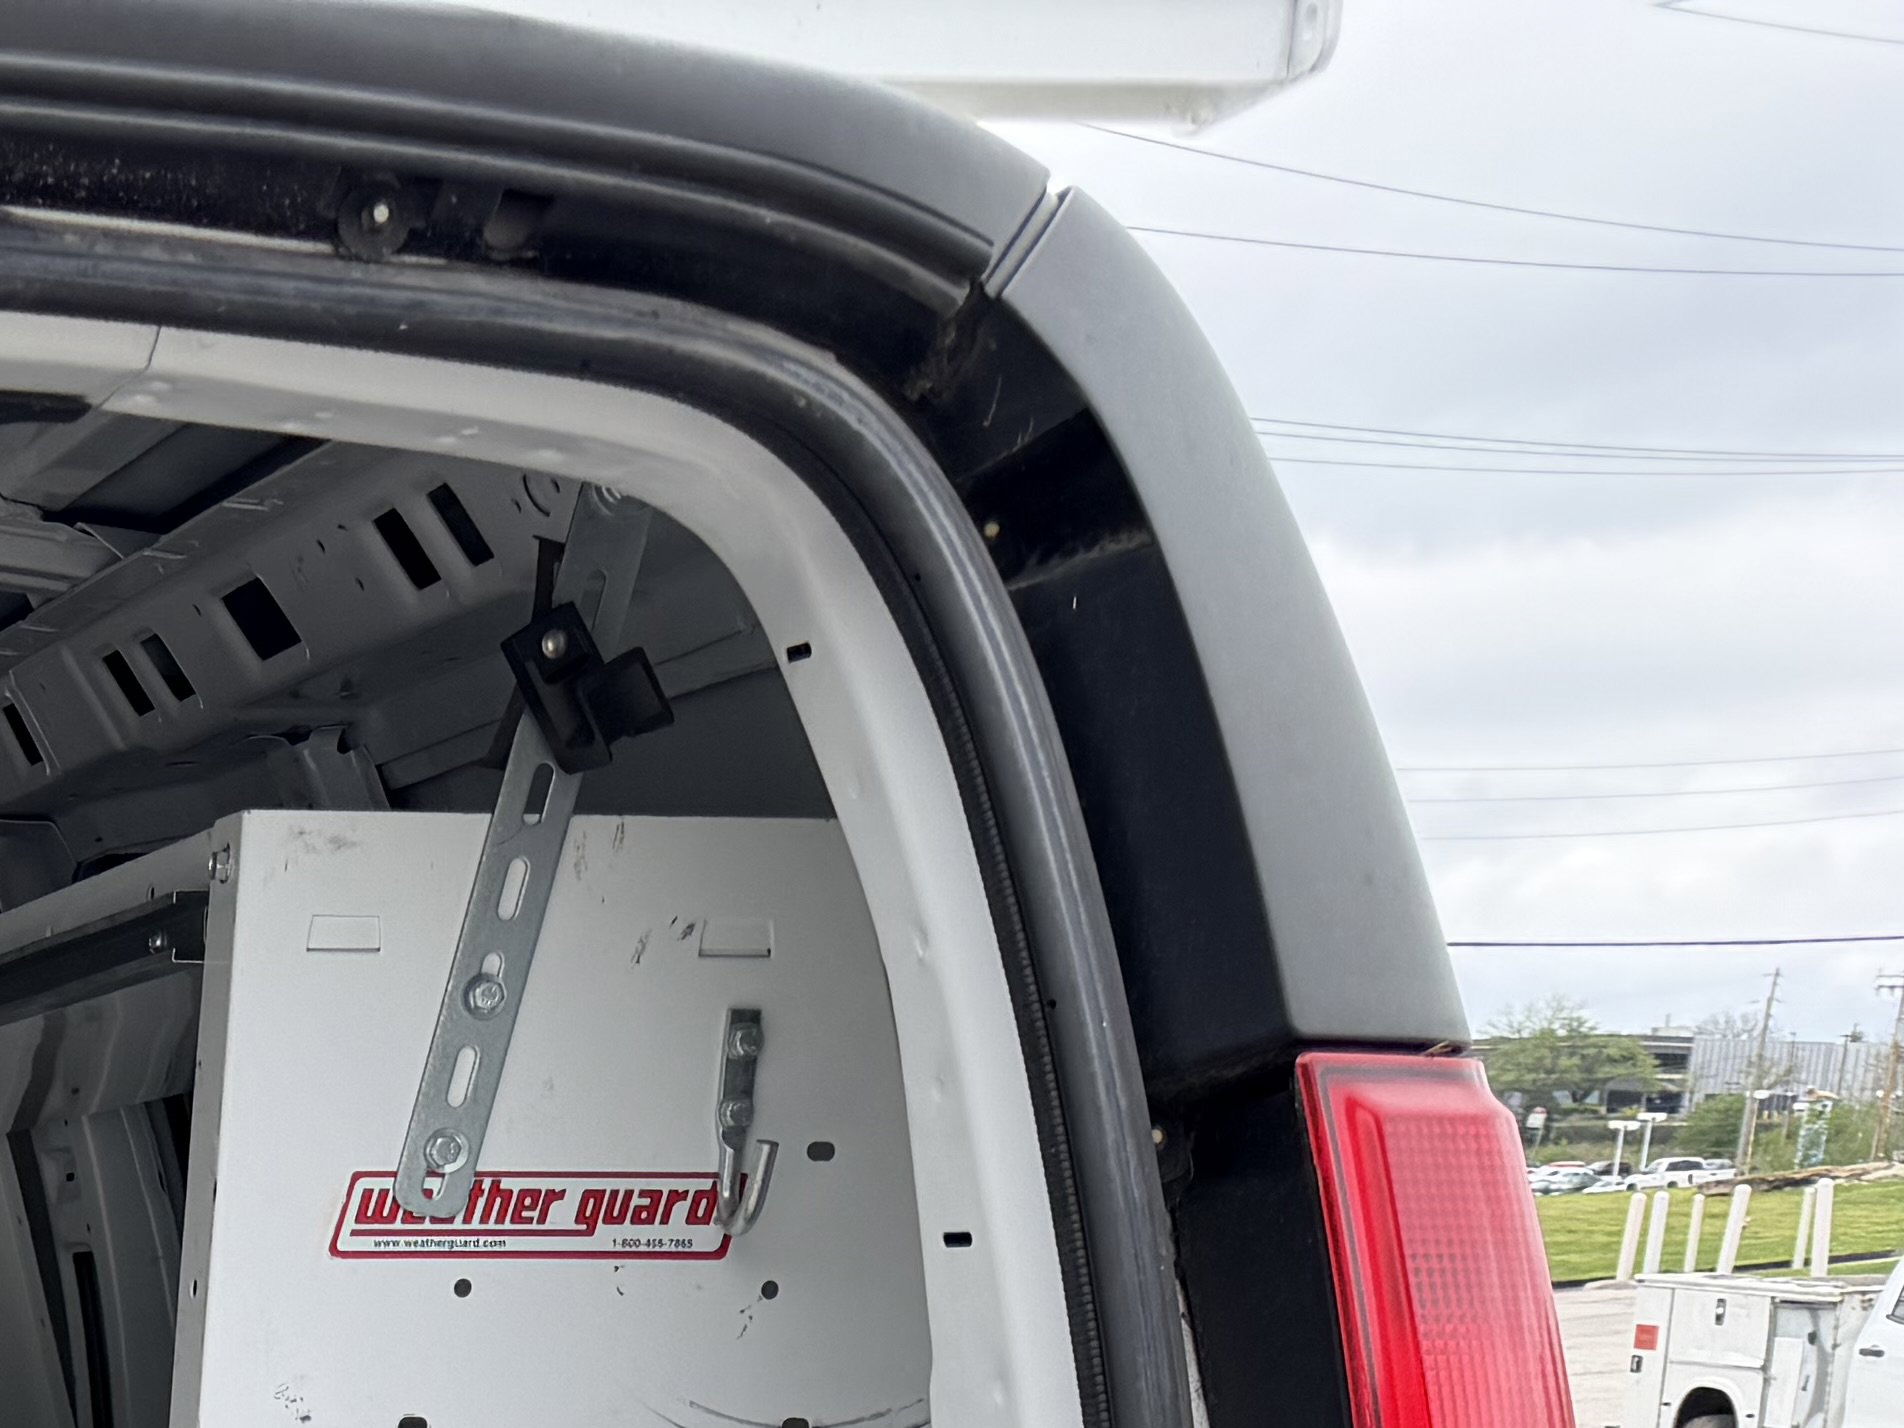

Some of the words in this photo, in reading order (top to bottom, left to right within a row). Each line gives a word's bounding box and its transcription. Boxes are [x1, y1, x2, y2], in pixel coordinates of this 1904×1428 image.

[354, 1178, 567, 1225] wther
[574, 1179, 719, 1237] guard
[373, 1238, 507, 1250] www.weatherguard.com
